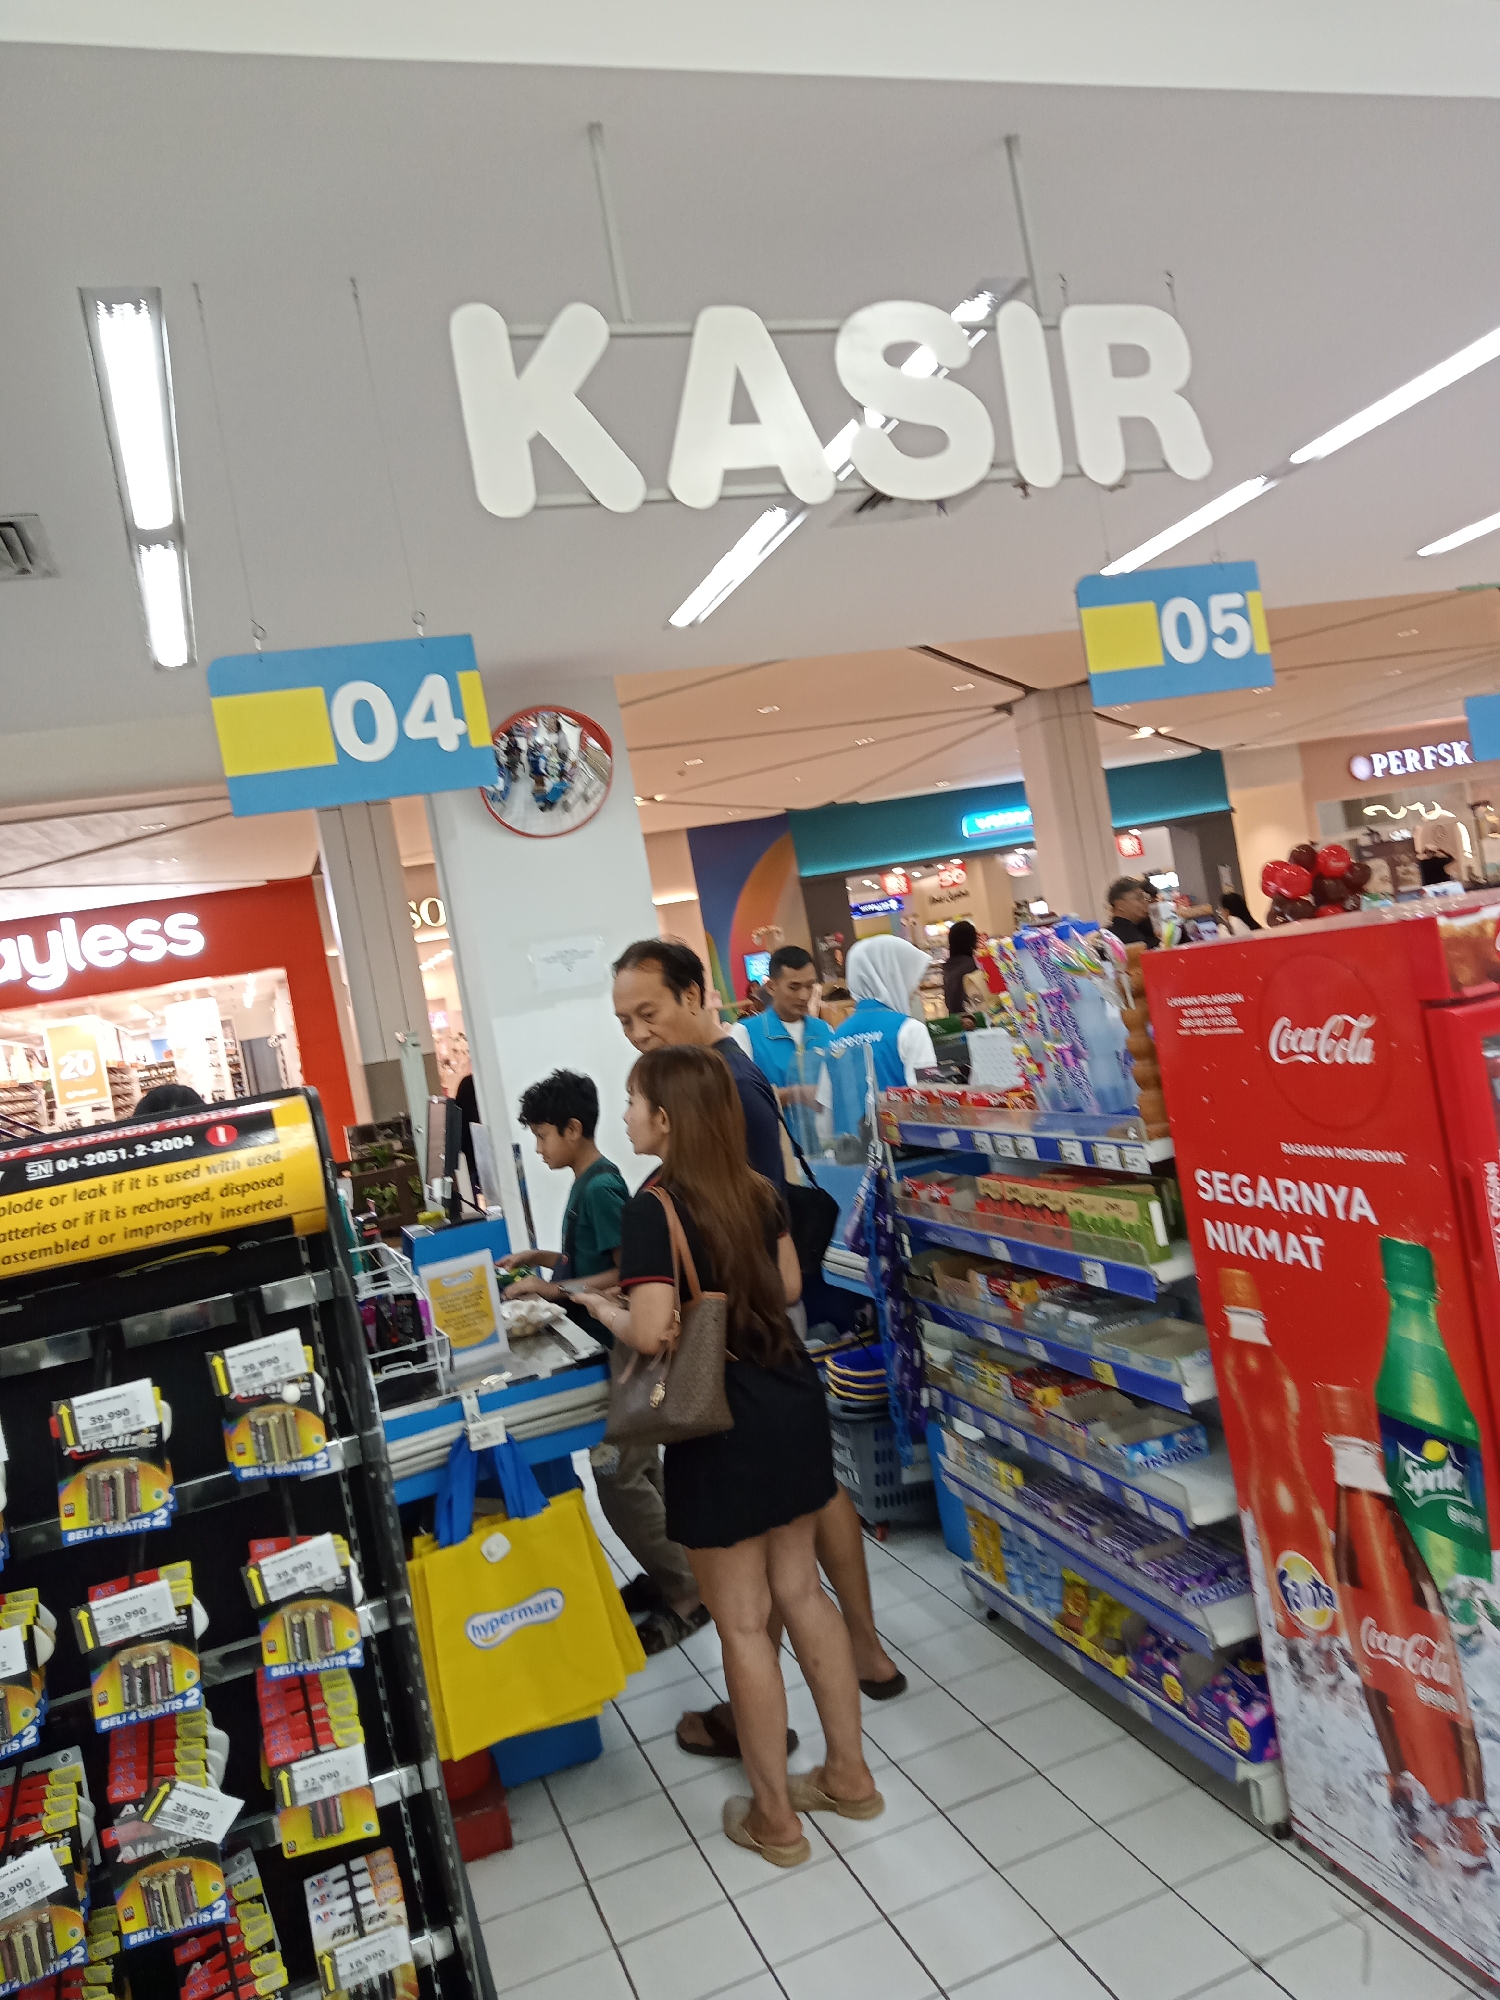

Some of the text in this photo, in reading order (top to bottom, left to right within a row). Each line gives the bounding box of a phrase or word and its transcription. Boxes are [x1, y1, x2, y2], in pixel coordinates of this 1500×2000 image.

[450, 301, 1213, 518] KASIR
[1161, 591, 1253, 664] 05
[330, 673, 468, 762] 04
[1370, 740, 1477, 778] PERFSK
[58, 1050, 97, 1080] 20
[25, 1159, 54, 1181] SNI
[49, 1193, 68, 1207] or
[73, 1182, 107, 1203] leak
[112, 1179, 125, 1195] if
[129, 1176, 141, 1191] it
[146, 1174, 159, 1188] is
[164, 1163, 201, 1184] used
[206, 1157, 241, 1175] with
[246, 1150, 281, 1168] used
[62, 1216, 80, 1230] or
[84, 1210, 96, 1226] if
[99, 1206, 111, 1224] it
[115, 1205, 127, 1220] is
[132, 1187, 215, 1216] recharged,
[220, 1172, 285, 1198] disposed
[1194, 1168, 1380, 1226] SEGARNYA
[1, 1194, 289, 1266] assembled or improperly inserted.
[1202, 1217, 1325, 1272] NIKMAT
[89, 1408, 130, 1426] 39,990
[315, 1450, 329, 1469] 2
[151, 1507, 168, 1527] 2
[107, 1607, 147, 1626] 39,990
[471, 1597, 558, 1640] hypermart
[347, 1647, 362, 1665] 2
[101, 1714, 127, 1730] BELI
[184, 1688, 200, 1707] 2
[21, 1725, 37, 1747] 2
[211, 1899, 227, 1921] 2
[70, 1945, 86, 1966] 2
